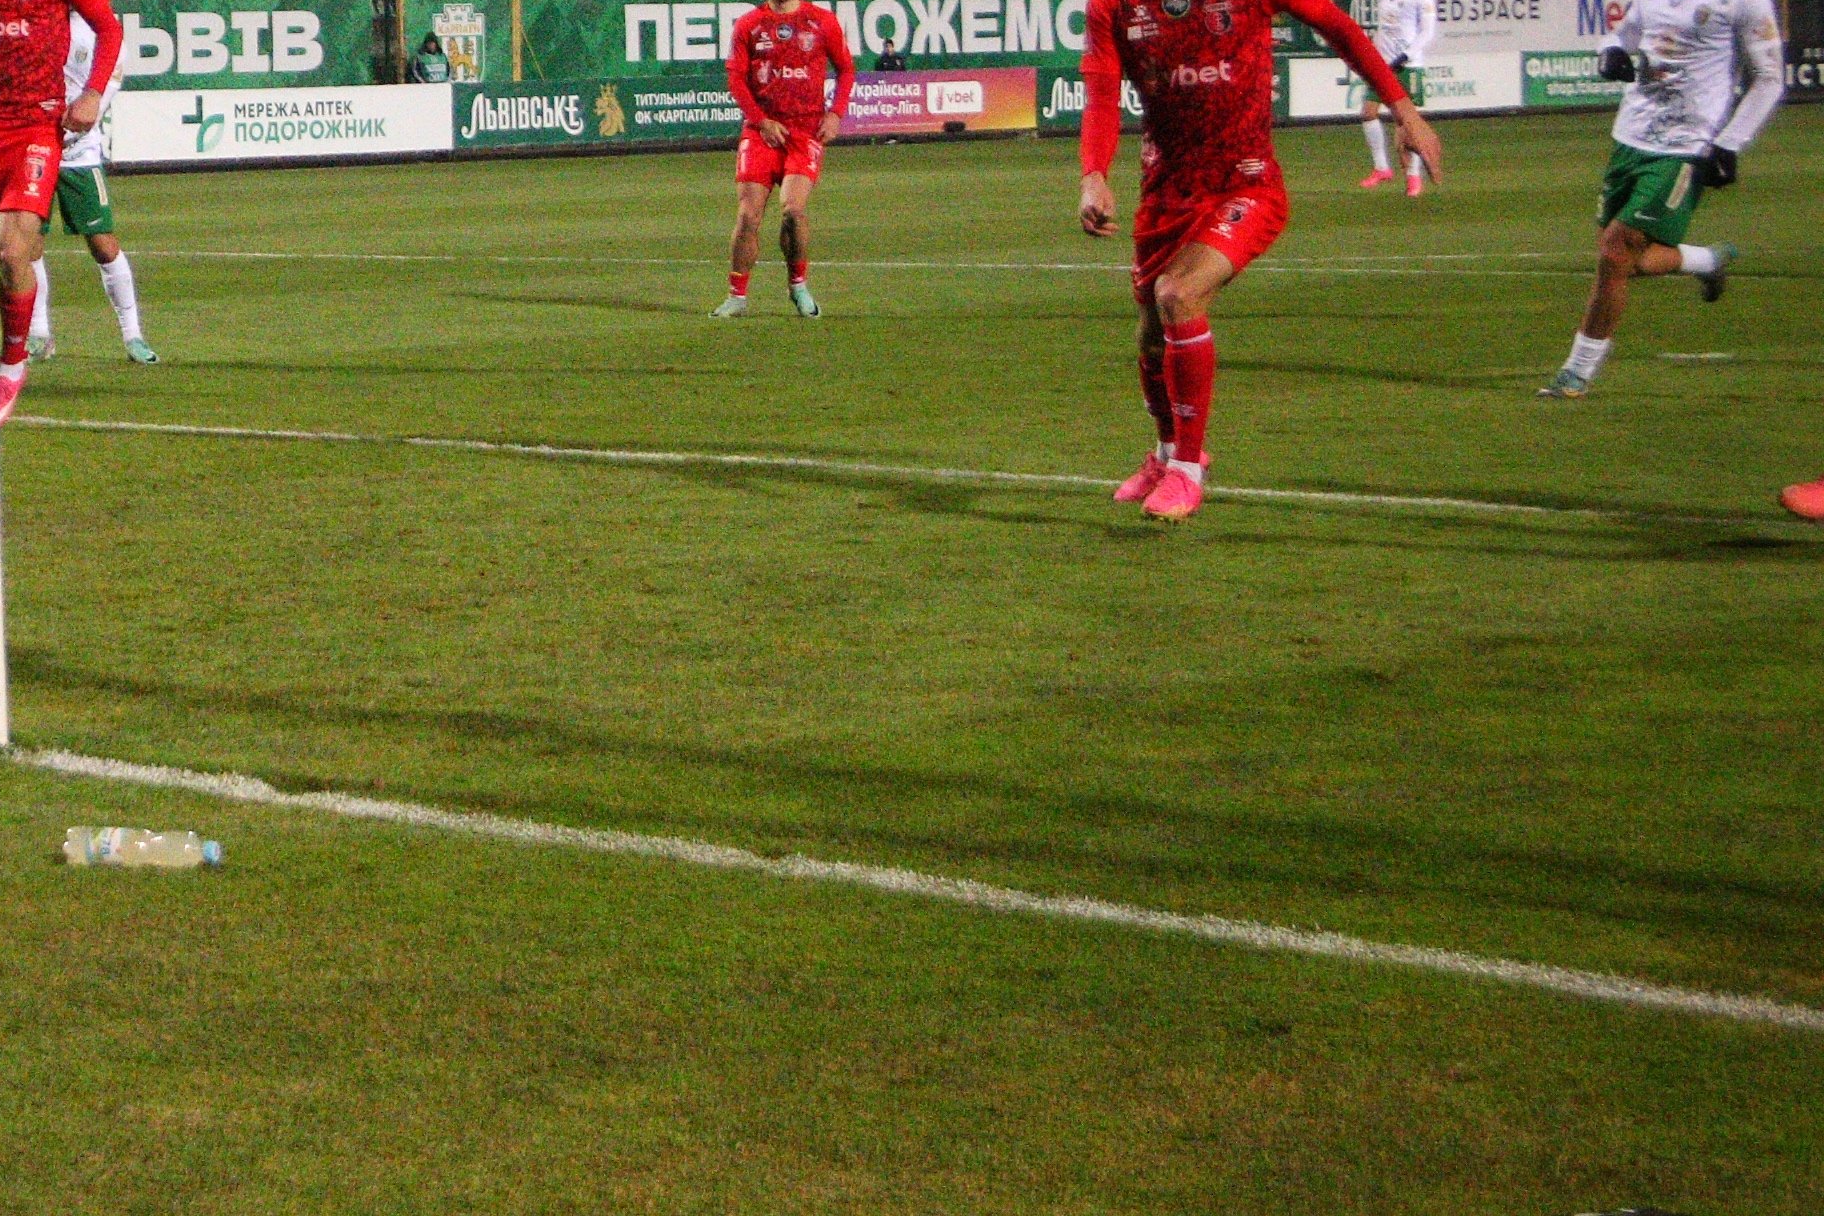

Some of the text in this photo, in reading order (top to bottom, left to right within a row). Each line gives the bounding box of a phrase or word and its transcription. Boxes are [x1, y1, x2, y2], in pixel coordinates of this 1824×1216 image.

[115, 10, 324, 77] ЬВІВ
[633, 90, 696, 106] ТИТУЛЬНИЙ
[946, 88, 976, 104] vbet
[234, 100, 354, 119] МЕРЕЖА АПТЕК
[461, 92, 585, 139] ЛЬВІВСЬКЕ
[635, 110, 652, 124] ФК
[235, 118, 387, 145] ПОДОРОЖНИК
